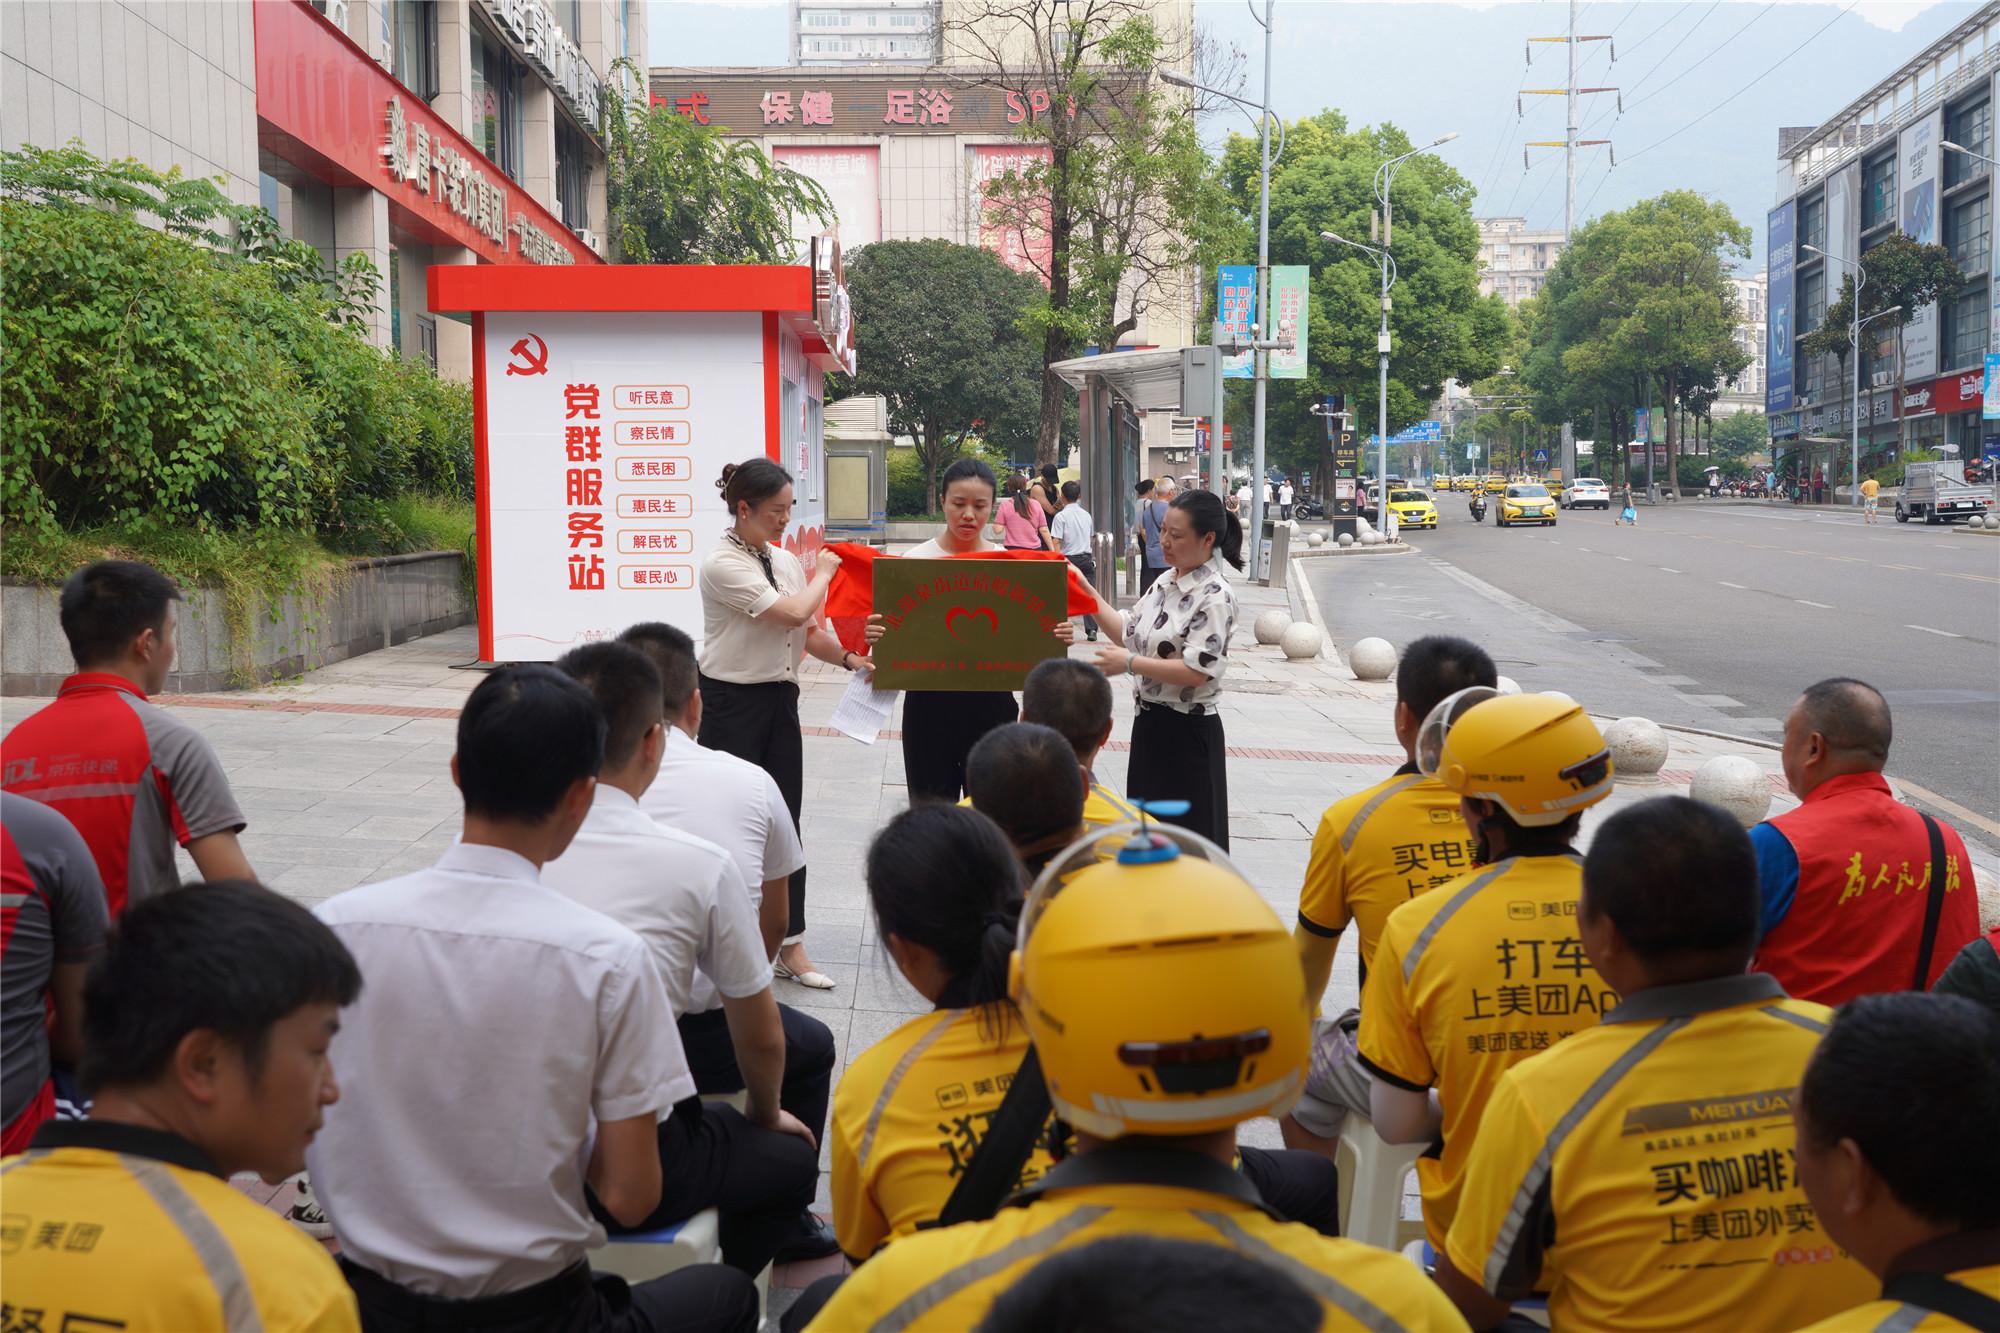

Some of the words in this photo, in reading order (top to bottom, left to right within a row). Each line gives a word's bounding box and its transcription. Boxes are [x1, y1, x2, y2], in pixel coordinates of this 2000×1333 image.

[761, 91, 834, 125] 保健
[885, 88, 953, 124] 足浴
[1007, 89, 1077, 123] SP
[629, 390, 674, 406] 听民意
[630, 425, 675, 441] 察民情
[1341, 433, 1351, 446] P
[631, 461, 676, 477] 悉民困
[563, 383, 605, 591] 党群服务站
[632, 498, 676, 514] 惠民生
[633, 534, 677, 549] 解民忧
[633, 569, 678, 585] 暖民心
[1496, 937, 1593, 979] 打车
[1467, 1031, 1549, 1054] 美团配送
[1652, 1148, 1798, 1205] 买咖啡
[1661, 1203, 1815, 1245] 上美团外卖
[33, 1221, 104, 1253] 美团
